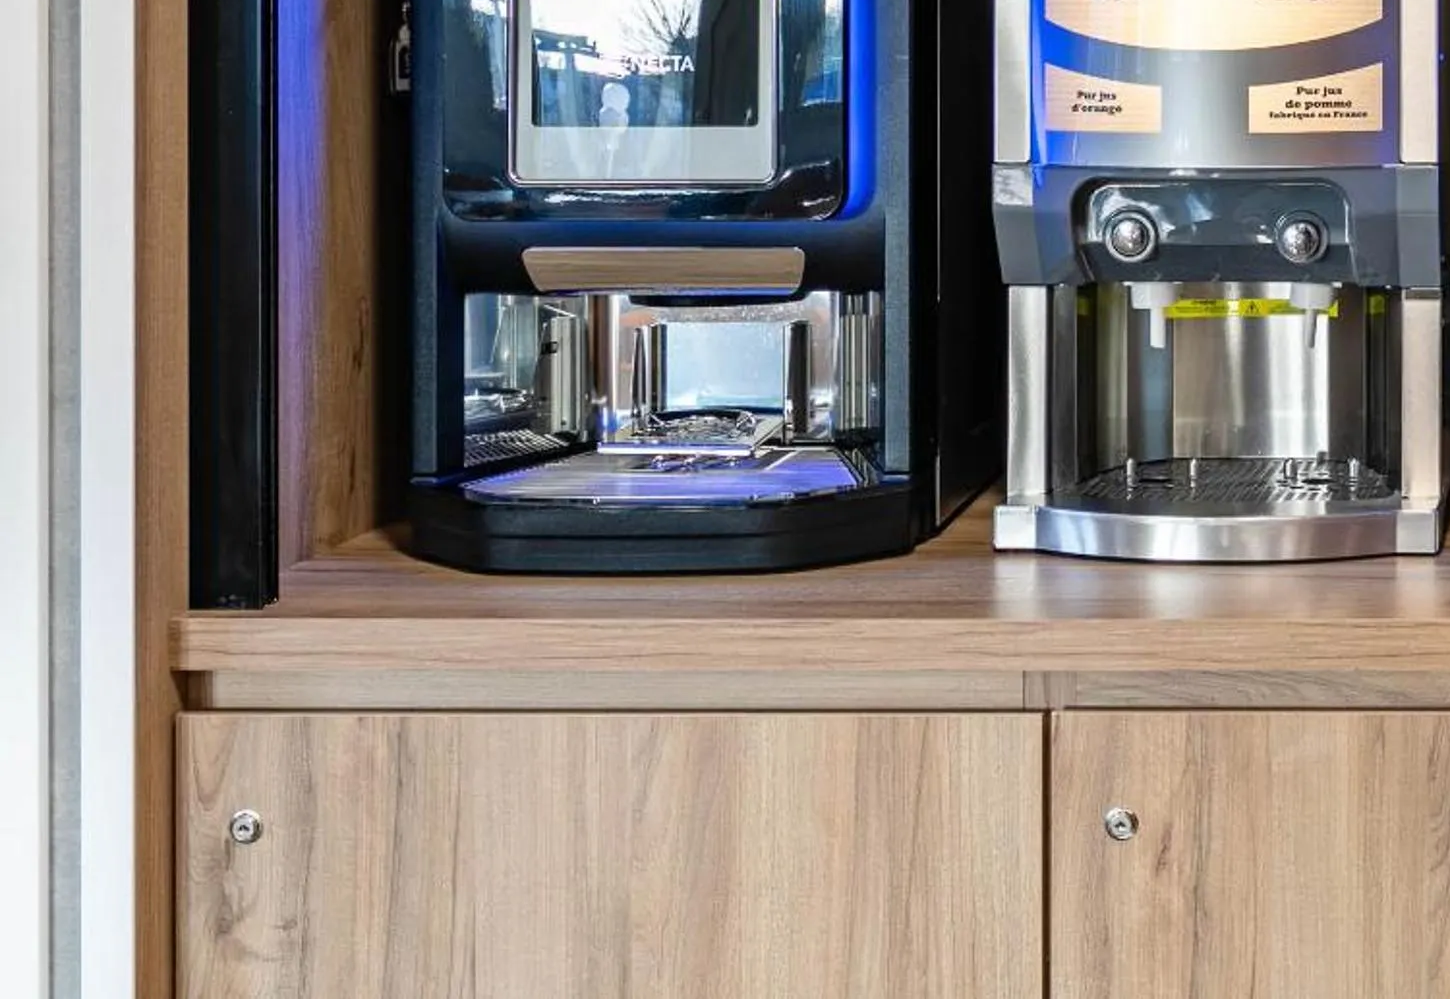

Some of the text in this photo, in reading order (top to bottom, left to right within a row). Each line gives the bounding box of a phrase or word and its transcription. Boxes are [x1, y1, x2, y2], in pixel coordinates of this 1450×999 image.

[1076, 90, 1097, 100] Pur
[1296, 86, 1342, 97] Pur jus
[1285, 100, 1352, 110] de pomme
